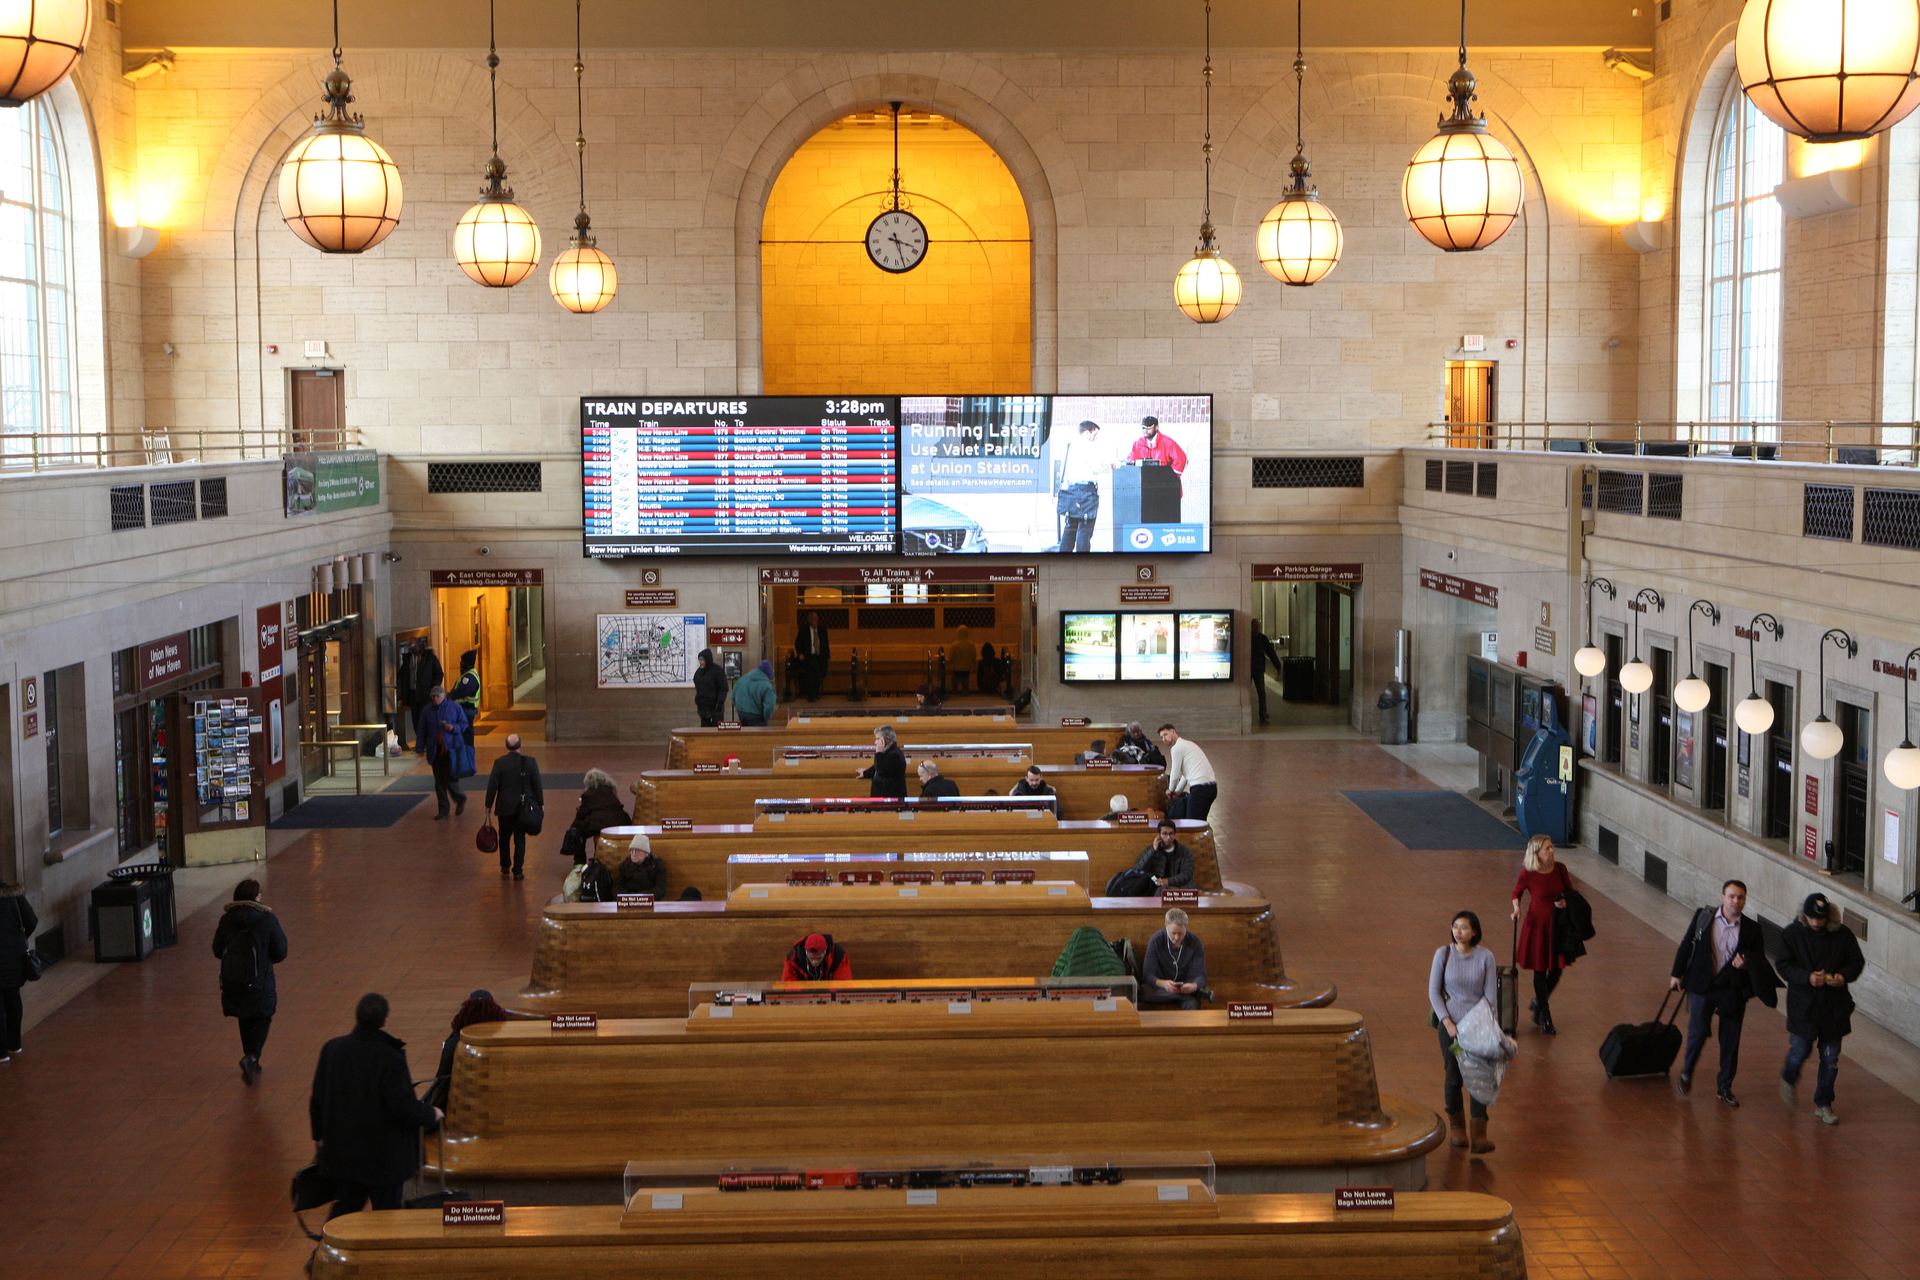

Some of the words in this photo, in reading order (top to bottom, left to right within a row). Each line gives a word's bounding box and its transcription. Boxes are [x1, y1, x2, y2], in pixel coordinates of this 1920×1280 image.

[309, 342, 321, 352] EXIT
[1468, 336, 1481, 346] EXIT
[585, 403, 636, 415] TRAIN
[642, 402, 747, 415] DEPARTURES
[826, 400, 884, 415] 3:28pm
[911, 423, 982, 440] Running
[990, 423, 1038, 437] Late?
[911, 444, 938, 455] Use
[943, 443, 979, 455] Valet
[985, 443, 1039, 458] Parking
[911, 462, 925, 474] at
[931, 462, 972, 474] Union
[977, 462, 1034, 474] Station.
[267, 624, 278, 634] Webster
[150, 648, 164, 663] Union
[165, 645, 178, 658] News
[149, 666, 154, 679] of
[155, 664, 166, 677] New
[167, 660, 181, 673] Haven
